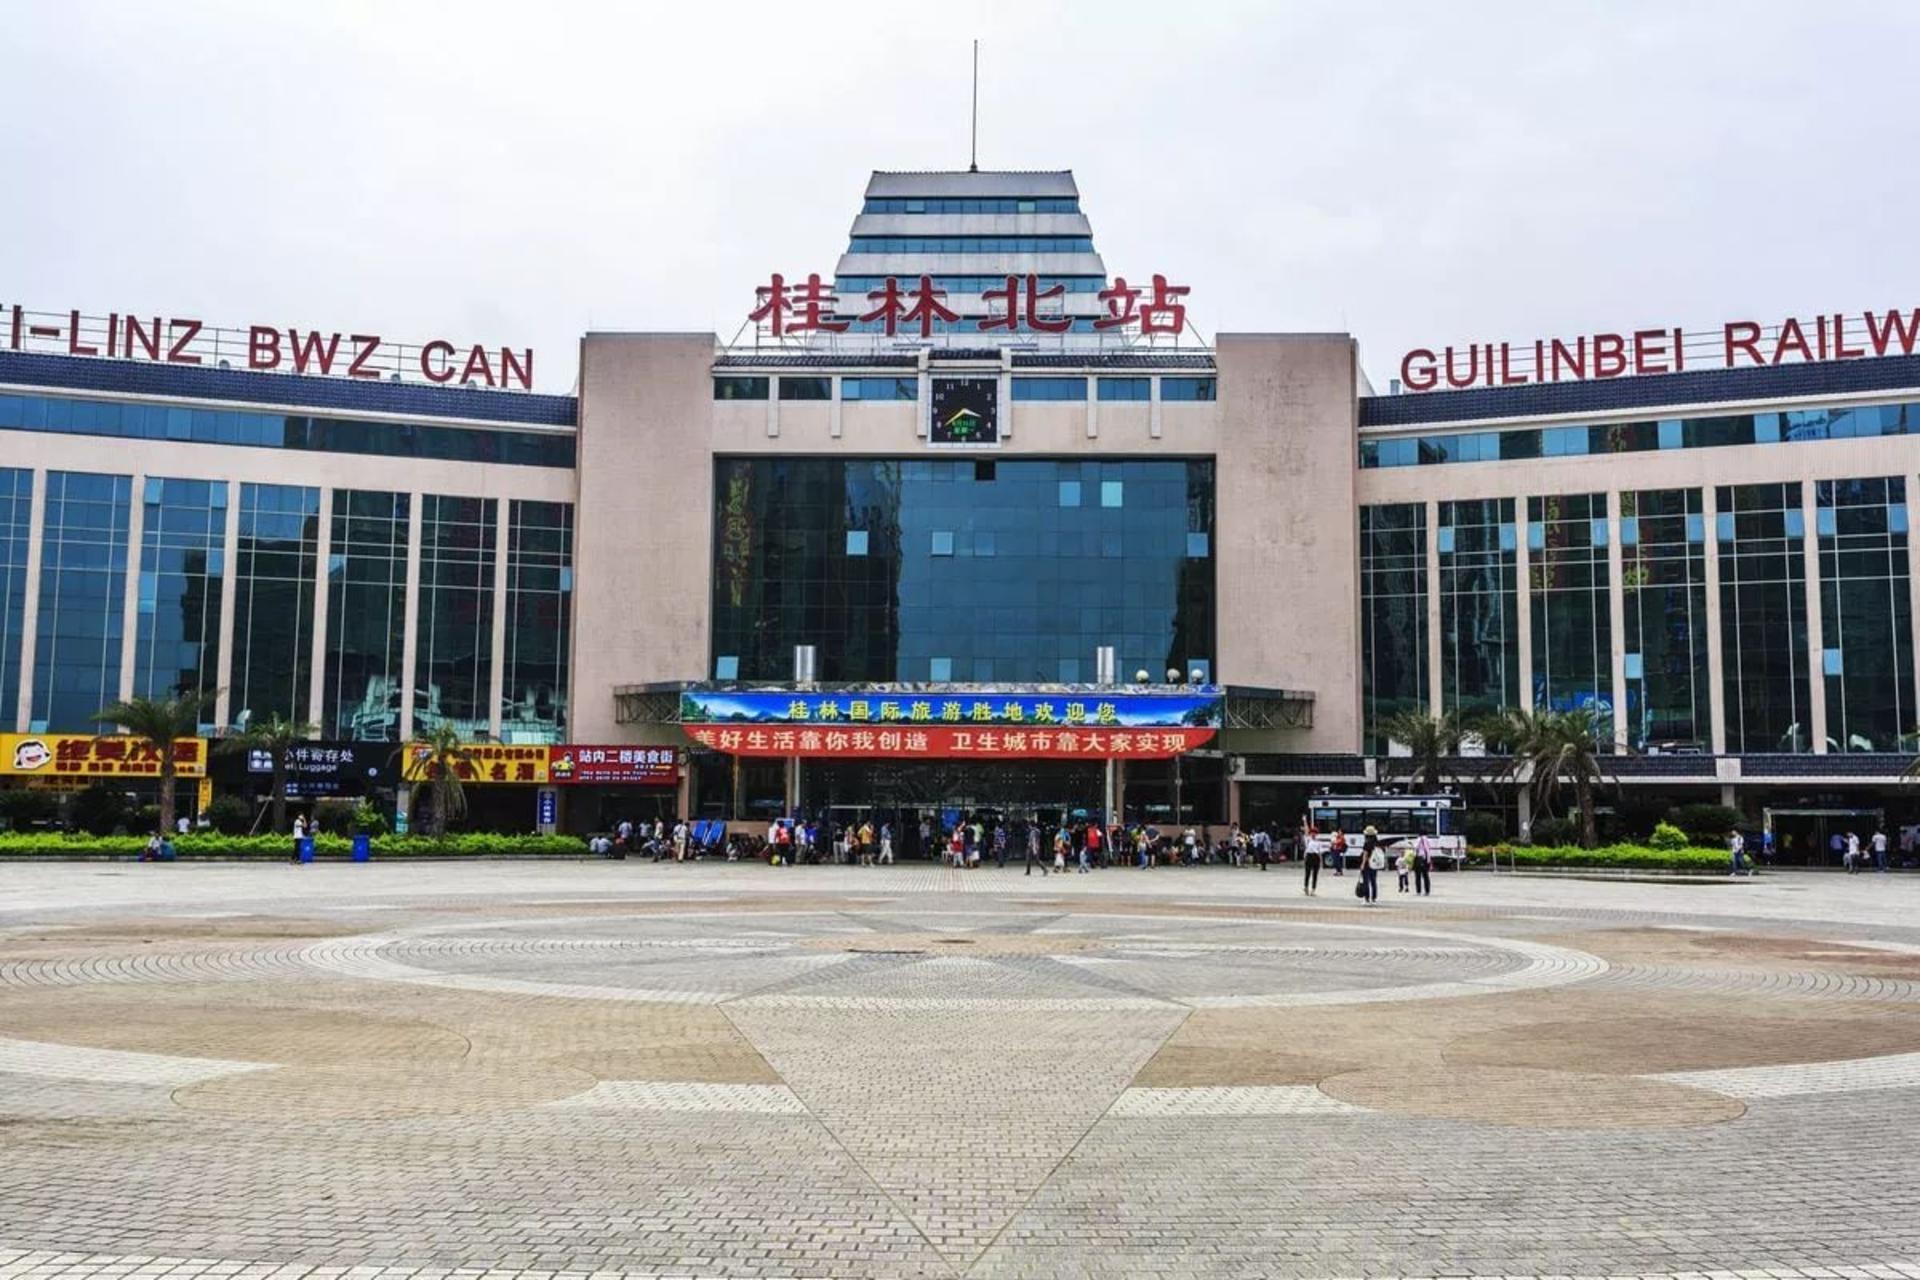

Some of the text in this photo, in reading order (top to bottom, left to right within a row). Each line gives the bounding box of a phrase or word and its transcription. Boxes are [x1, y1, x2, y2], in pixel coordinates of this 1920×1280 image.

[748, 273, 1191, 337] 桂林北站
[0, 304, 534, 389] I-LINZ BWZ CAN
[1400, 308, 1920, 391] GUILINBEI RAILW
[788, 701, 1117, 721] 桂林国际旅游胜地欢迎您
[695, 731, 1187, 751] 美好生活靠你我创造 卫生城市靠大家实现
[579, 750, 673, 763] 站内二楼美食街
[299, 763, 337, 772] Luggage
